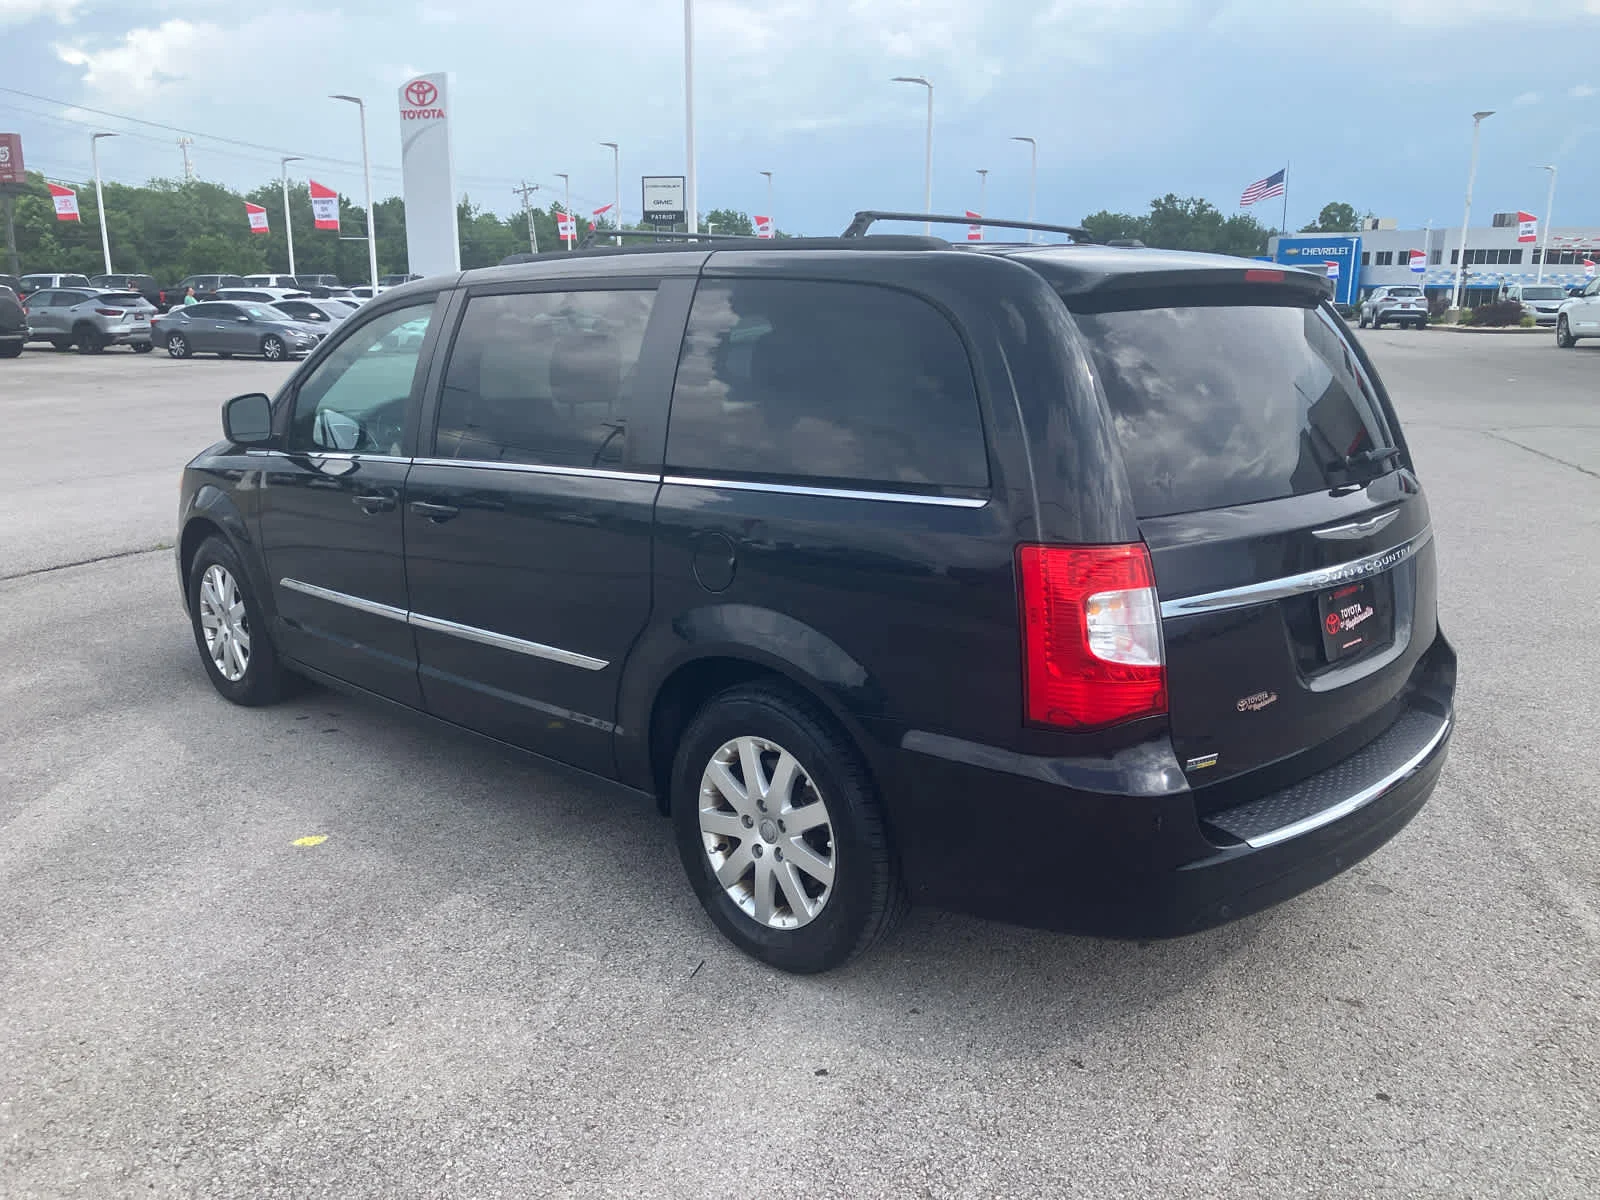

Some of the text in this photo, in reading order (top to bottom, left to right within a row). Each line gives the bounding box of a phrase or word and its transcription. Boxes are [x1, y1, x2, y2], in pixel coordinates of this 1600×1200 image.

[400, 108, 445, 120] TOYOTA
[1301, 246, 1350, 256] CHEVROLET
[1340, 602, 1362, 619] TOYOTA
[1247, 690, 1269, 705] TOYOTA
